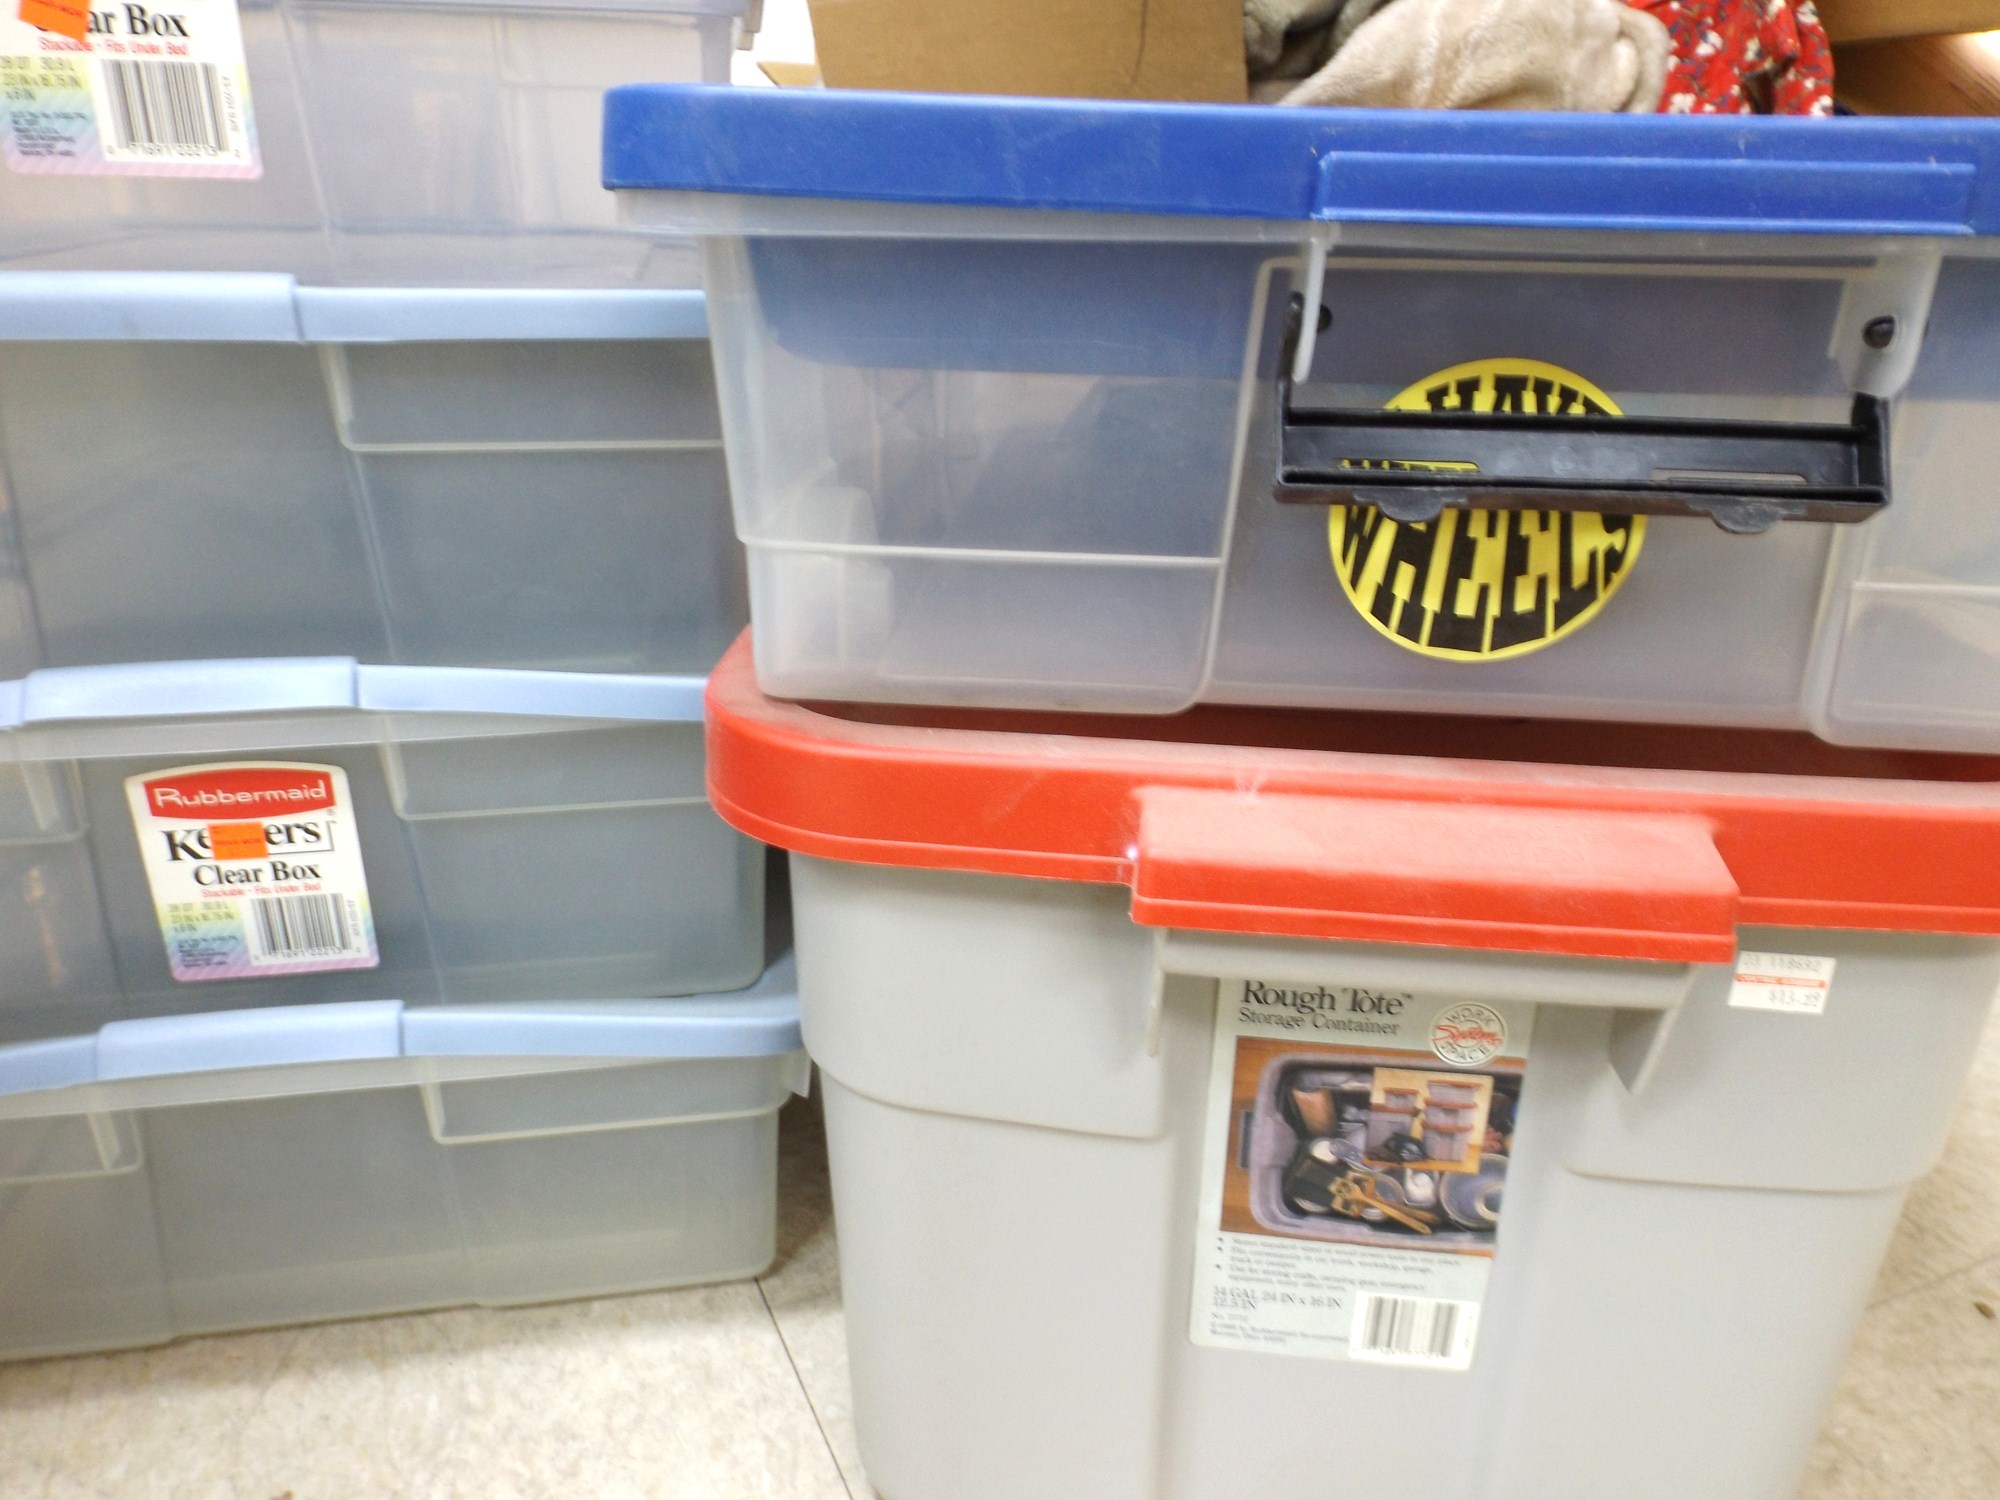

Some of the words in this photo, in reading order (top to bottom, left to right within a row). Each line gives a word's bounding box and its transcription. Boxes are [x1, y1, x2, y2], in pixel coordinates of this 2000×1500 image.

[121, 3, 190, 37] Box
[153, 780, 327, 809] Rubbermaid
[161, 820, 323, 862] Keers
[194, 864, 262, 887] Clear
[269, 860, 322, 882] Box
[202, 886, 246, 898] Stackable
[255, 884, 271, 896] Fits
[303, 881, 322, 892] Bed
[1240, 980, 1337, 1015] Rough
[1239, 1007, 1305, 1030] Storage
[1312, 1012, 1401, 1035] Container
